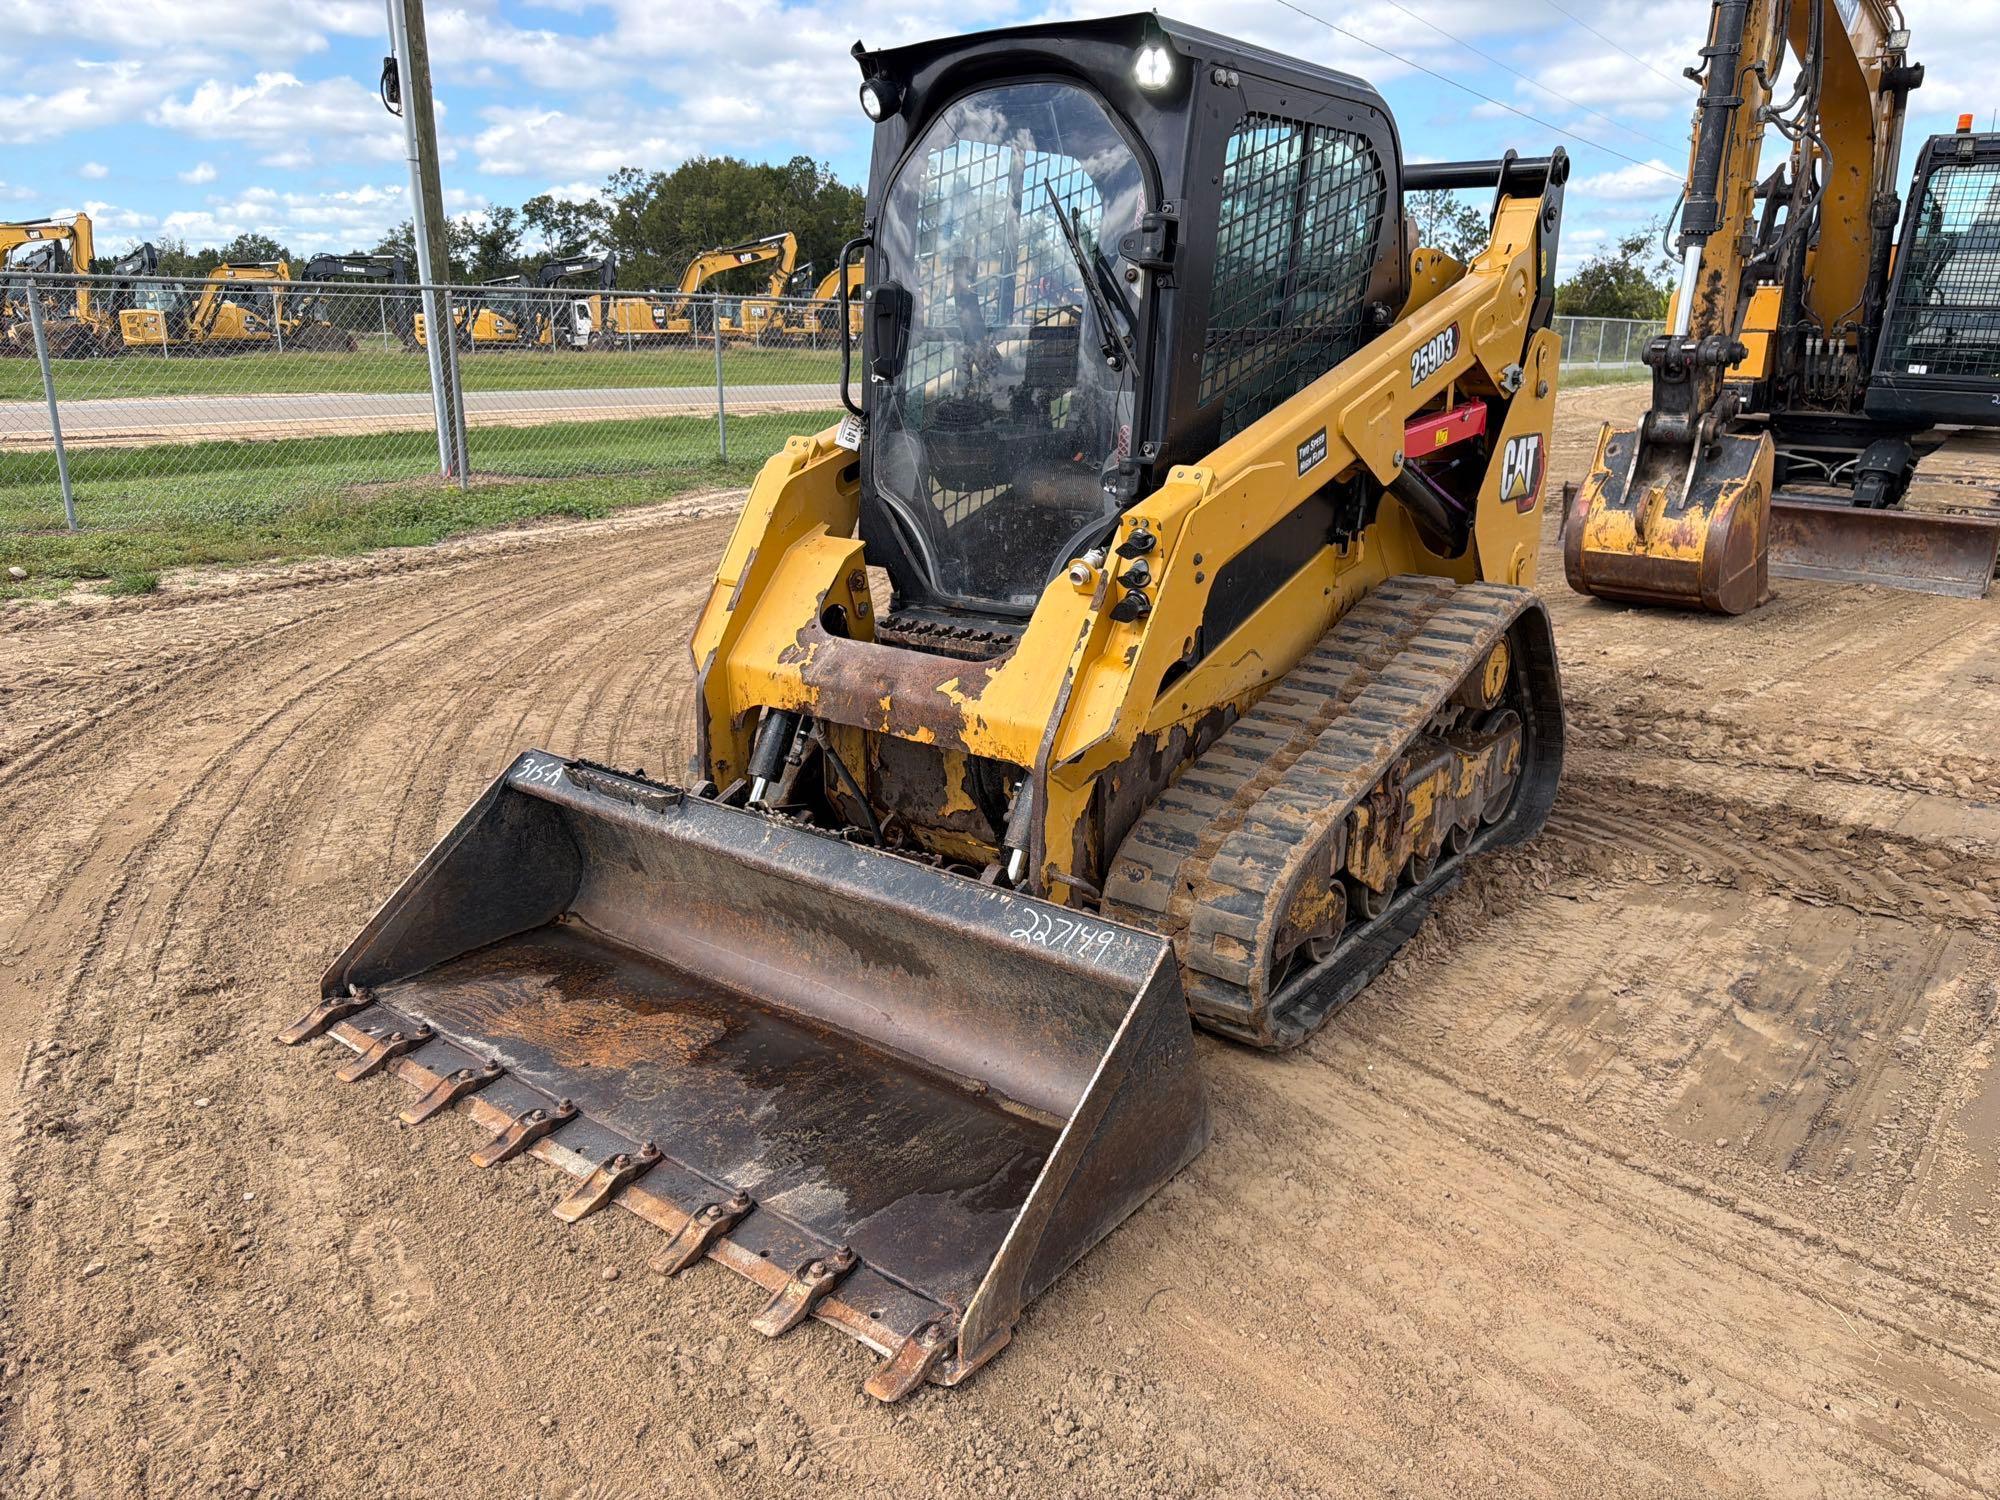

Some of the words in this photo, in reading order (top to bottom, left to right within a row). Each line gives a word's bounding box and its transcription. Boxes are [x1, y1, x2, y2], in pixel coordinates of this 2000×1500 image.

[343, 265, 366, 274] DEERE
[739, 252, 753, 264] CAT
[751, 307, 765, 317] CAT
[1411, 327, 1454, 387] 259D3
[1299, 444, 1310, 460] TWO
[1310, 433, 1325, 451] SPEED
[1500, 435, 1539, 501] CAT
[515, 758, 563, 786] 315-A
[1010, 907, 1116, 965] 227149
